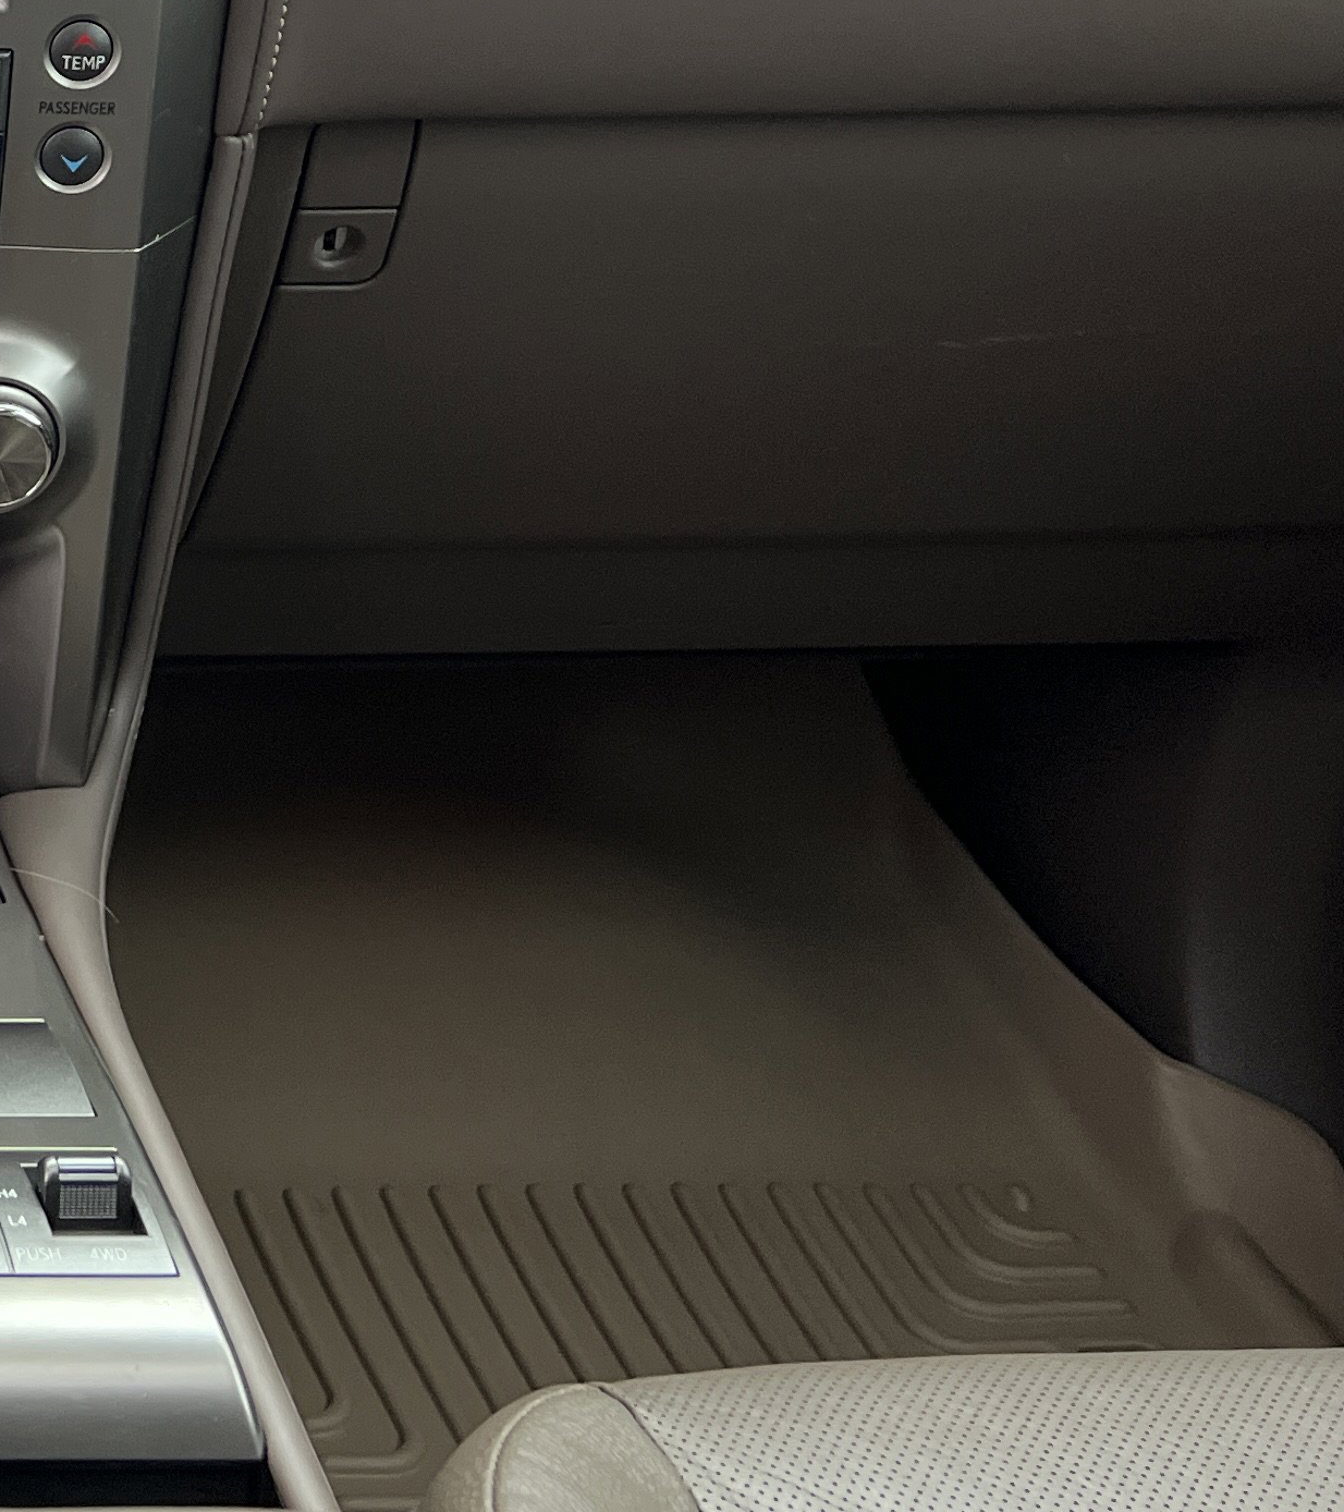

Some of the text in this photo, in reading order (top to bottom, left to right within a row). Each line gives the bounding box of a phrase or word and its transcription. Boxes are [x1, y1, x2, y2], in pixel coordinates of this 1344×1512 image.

[61, 55, 106, 71] TEMP
[38, 100, 116, 116] PASSENGER
[15, 1247, 129, 1263] PUSH 4WD
